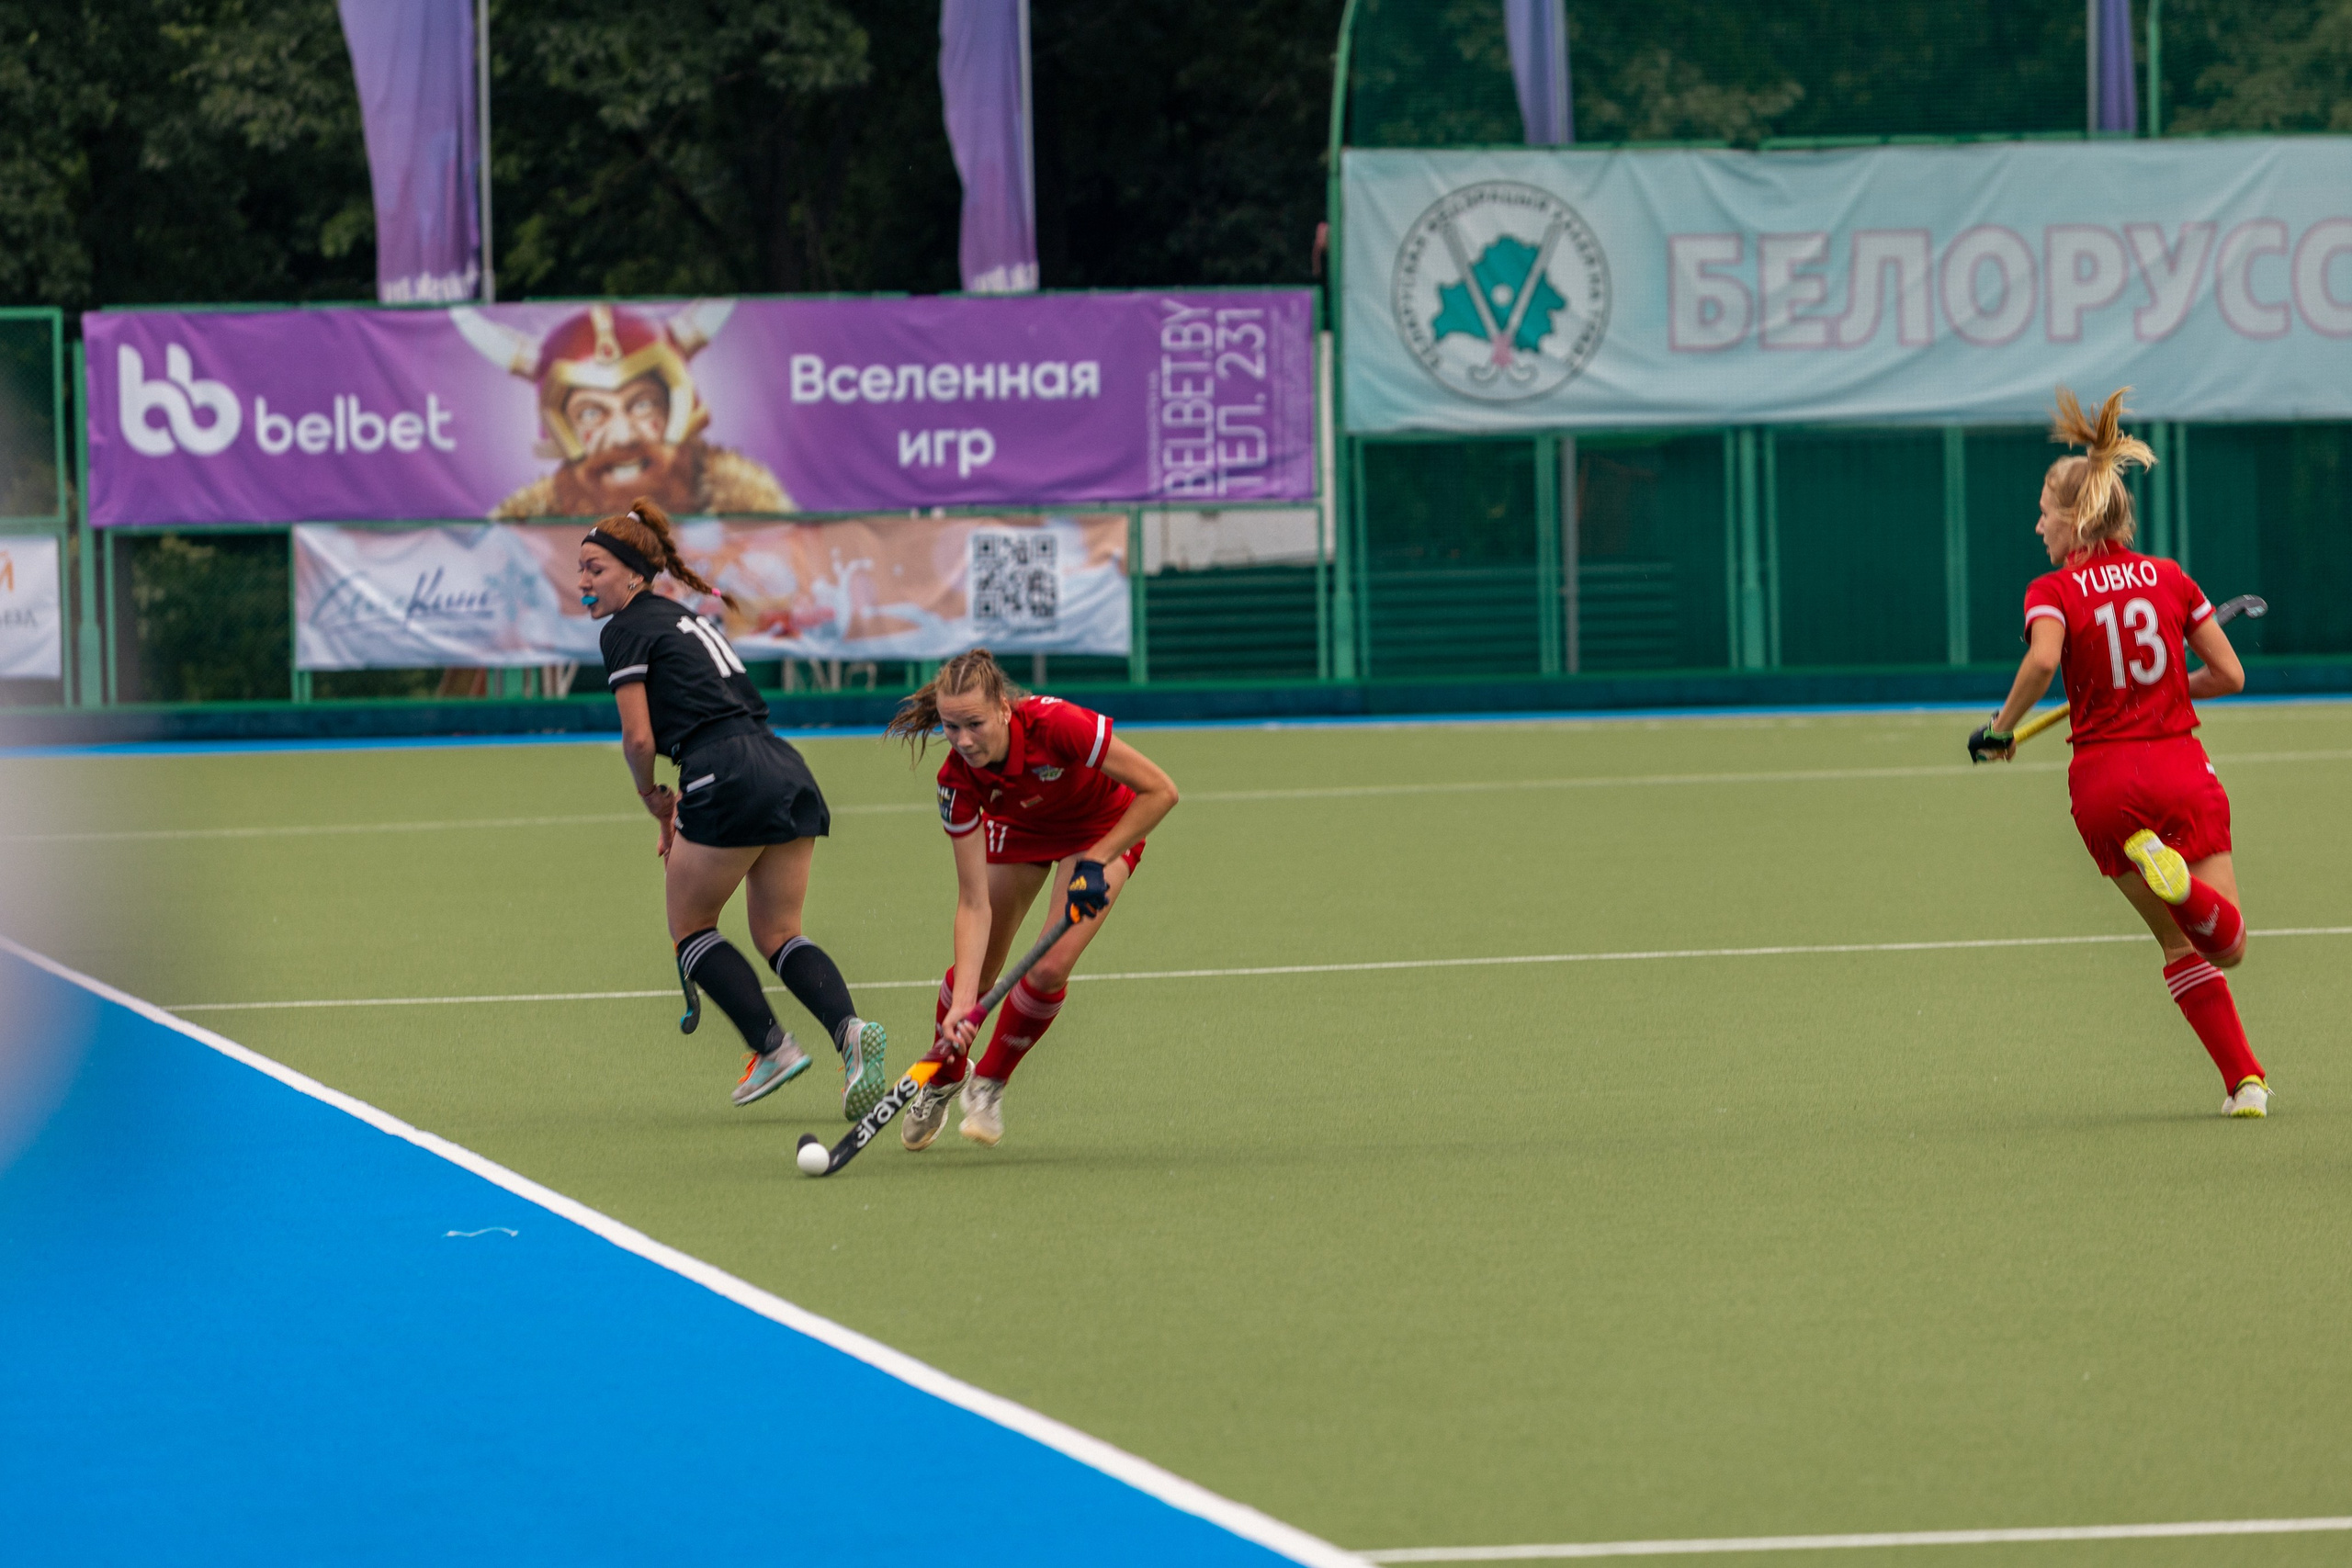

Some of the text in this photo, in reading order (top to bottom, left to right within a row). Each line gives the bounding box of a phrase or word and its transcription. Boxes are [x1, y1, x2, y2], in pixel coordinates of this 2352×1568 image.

[1668, 216, 2352, 354] БЕЛОРУСС
[789, 354, 1101, 403] Вселенная
[1215, 308, 1267, 497] ТЕЛ. 231
[254, 392, 457, 455] belbet
[897, 427, 996, 478] игр
[2072, 559, 2158, 597] YUBKO
[2094, 597, 2167, 689] 13
